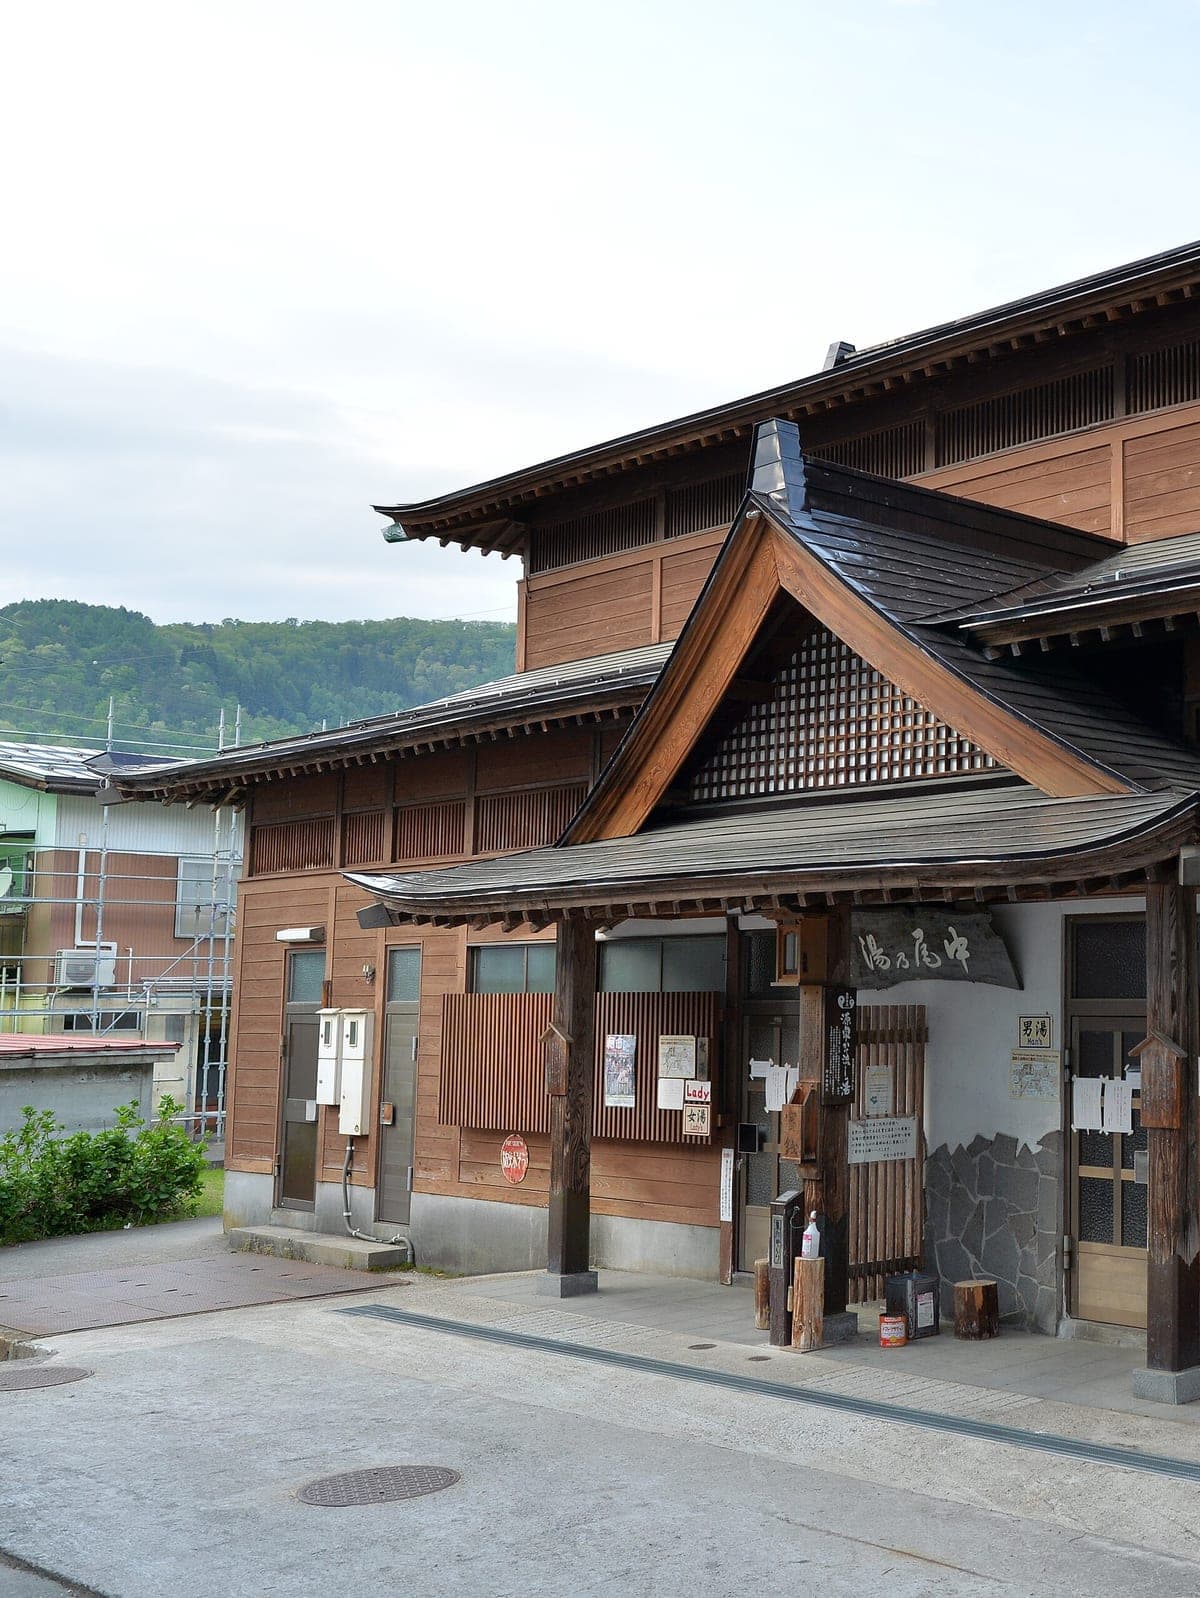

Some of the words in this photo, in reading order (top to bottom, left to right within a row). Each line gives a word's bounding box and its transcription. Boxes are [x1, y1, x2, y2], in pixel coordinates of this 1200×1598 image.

[1022, 1020, 1047, 1038] 男湯
[687, 1084, 710, 1100] Lady
[687, 1108, 706, 1124] 女湯
